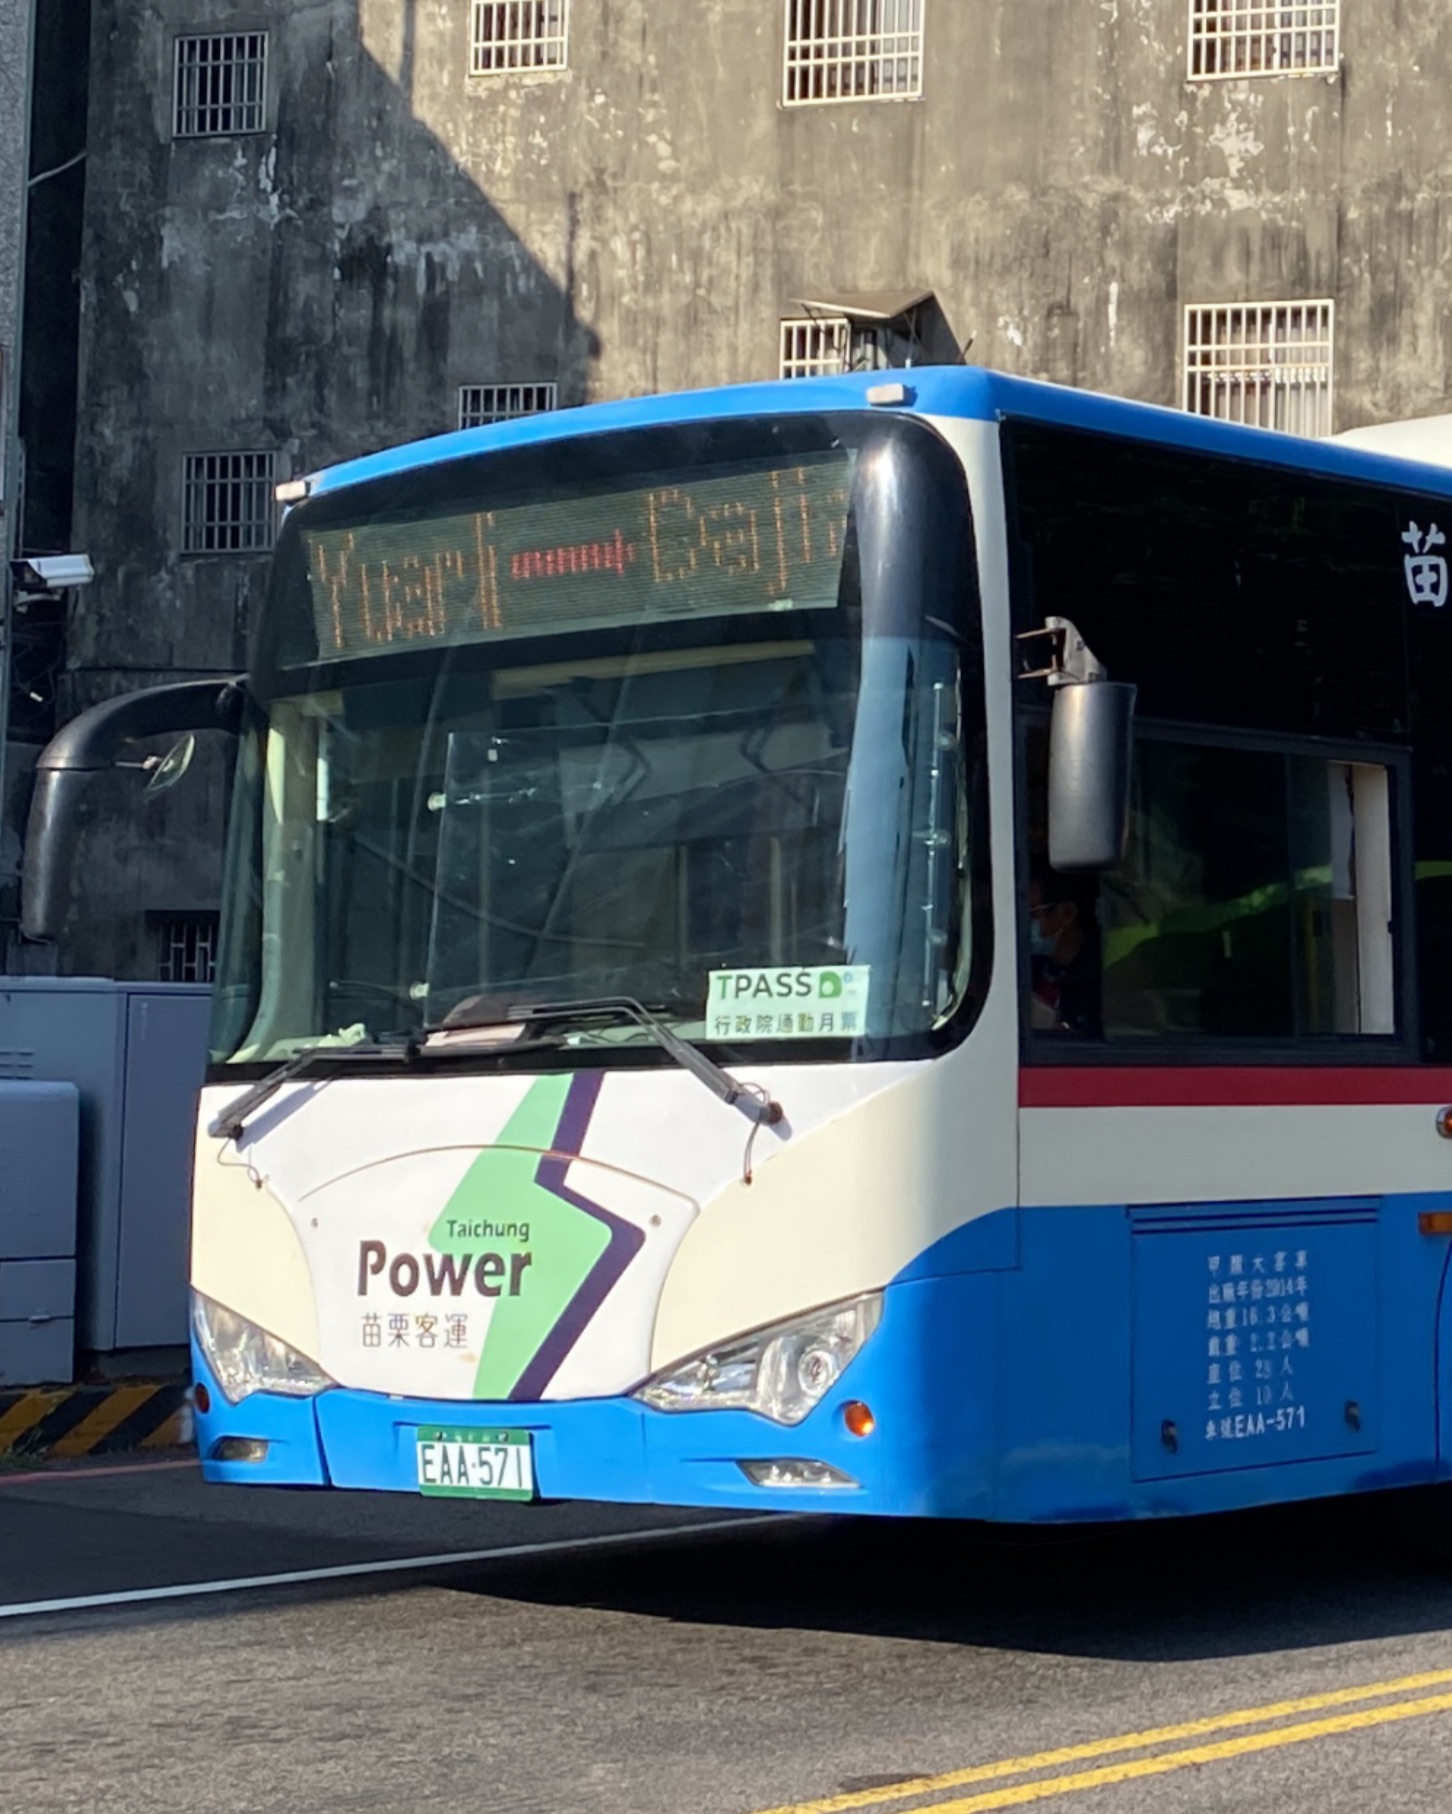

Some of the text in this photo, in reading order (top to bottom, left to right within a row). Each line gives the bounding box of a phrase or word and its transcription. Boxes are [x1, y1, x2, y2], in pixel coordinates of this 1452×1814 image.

[716, 972, 812, 999] TPASS
[715, 1011, 858, 1036] 行政院通勤月票
[446, 1219, 531, 1242] Taichung
[357, 1239, 532, 1298] Power
[361, 1312, 469, 1349] 苗栗客運
